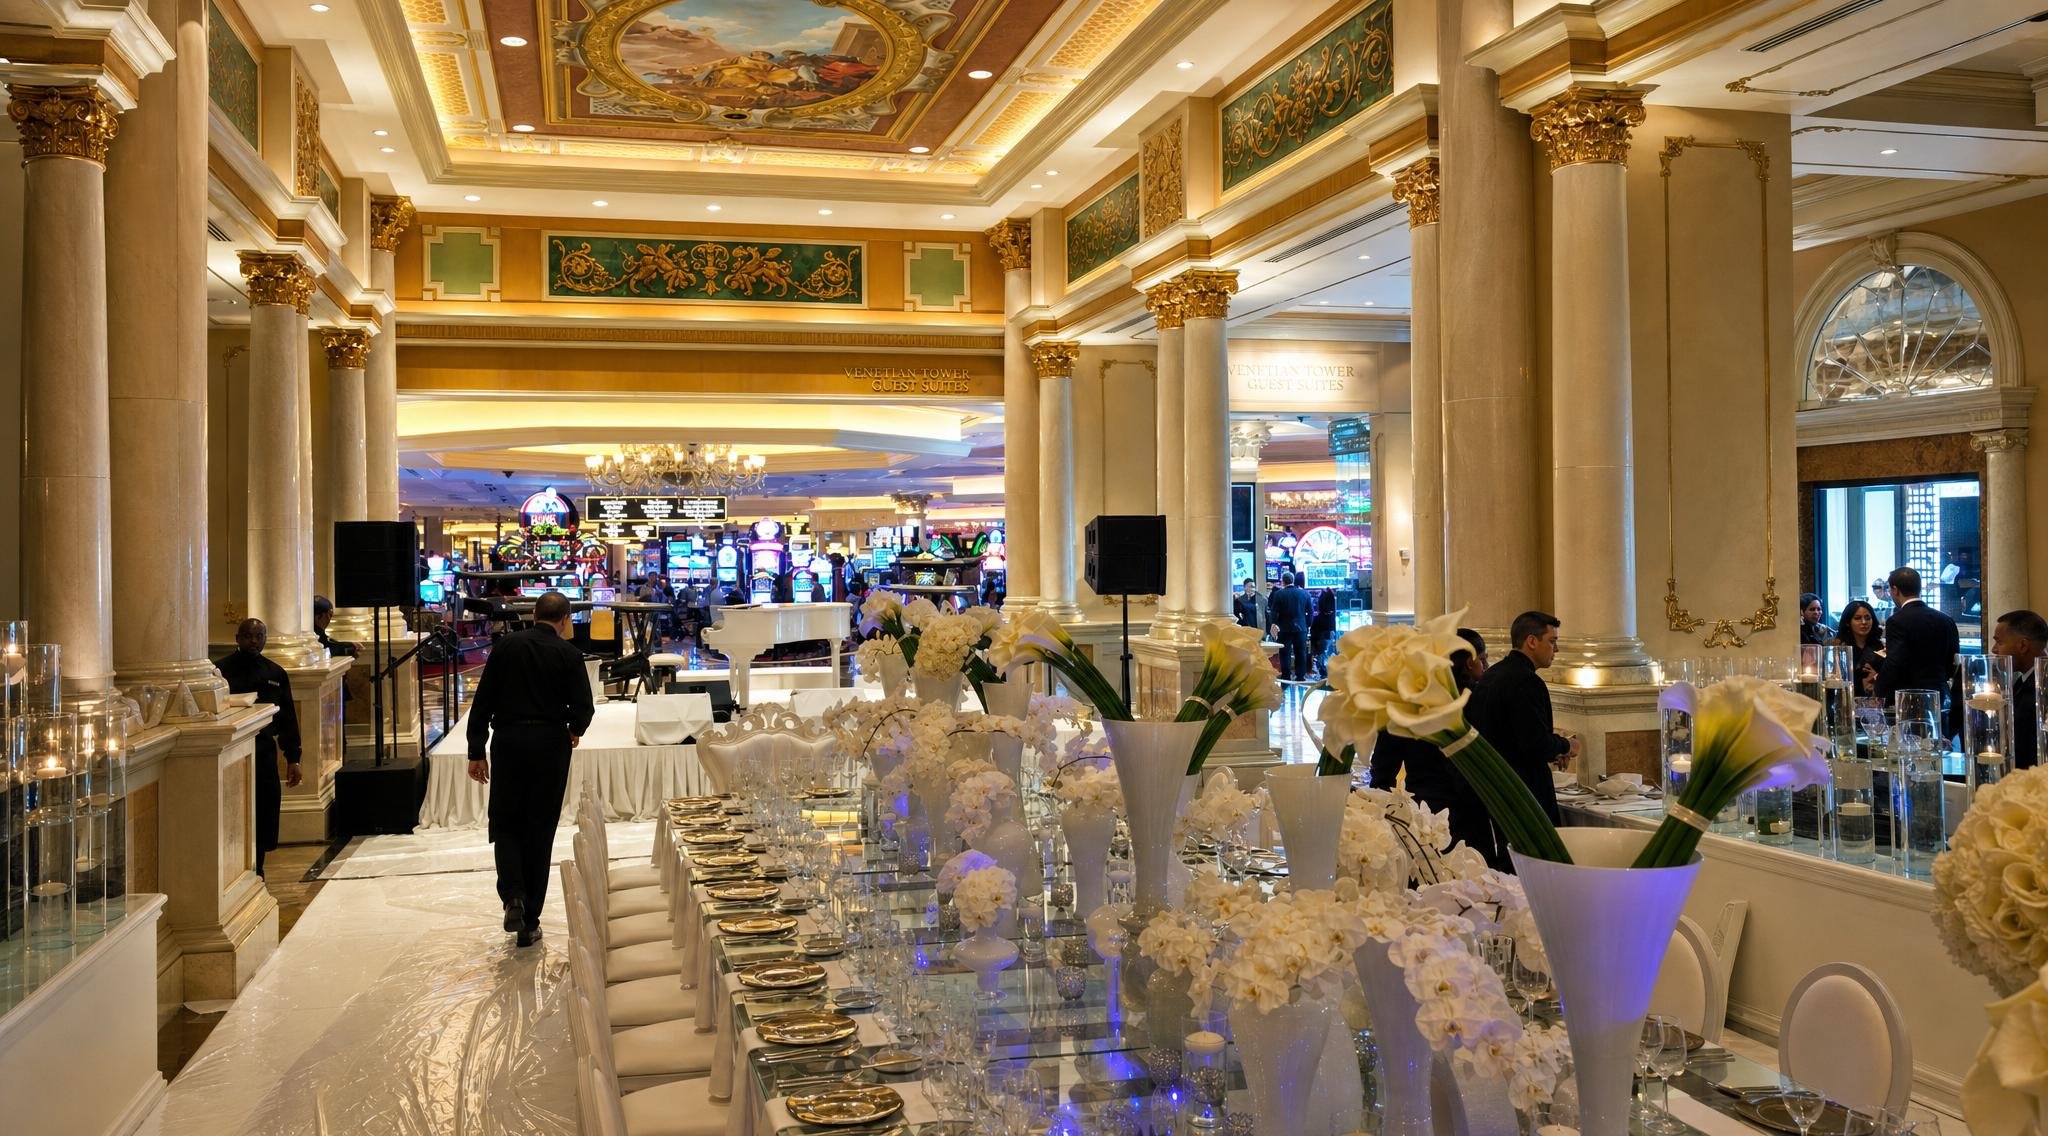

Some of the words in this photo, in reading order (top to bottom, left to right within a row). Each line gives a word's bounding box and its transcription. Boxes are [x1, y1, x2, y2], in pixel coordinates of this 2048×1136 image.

[843, 367, 917, 379] VENETIAN
[921, 367, 971, 379] TOWER
[1228, 365, 1299, 377] VENETIAN
[1305, 365, 1355, 377] TOWER
[871, 379, 916, 393] GUEST
[921, 380, 969, 393] SUITES
[1247, 379, 1293, 391] GUEST
[1297, 379, 1344, 391] SUITES
